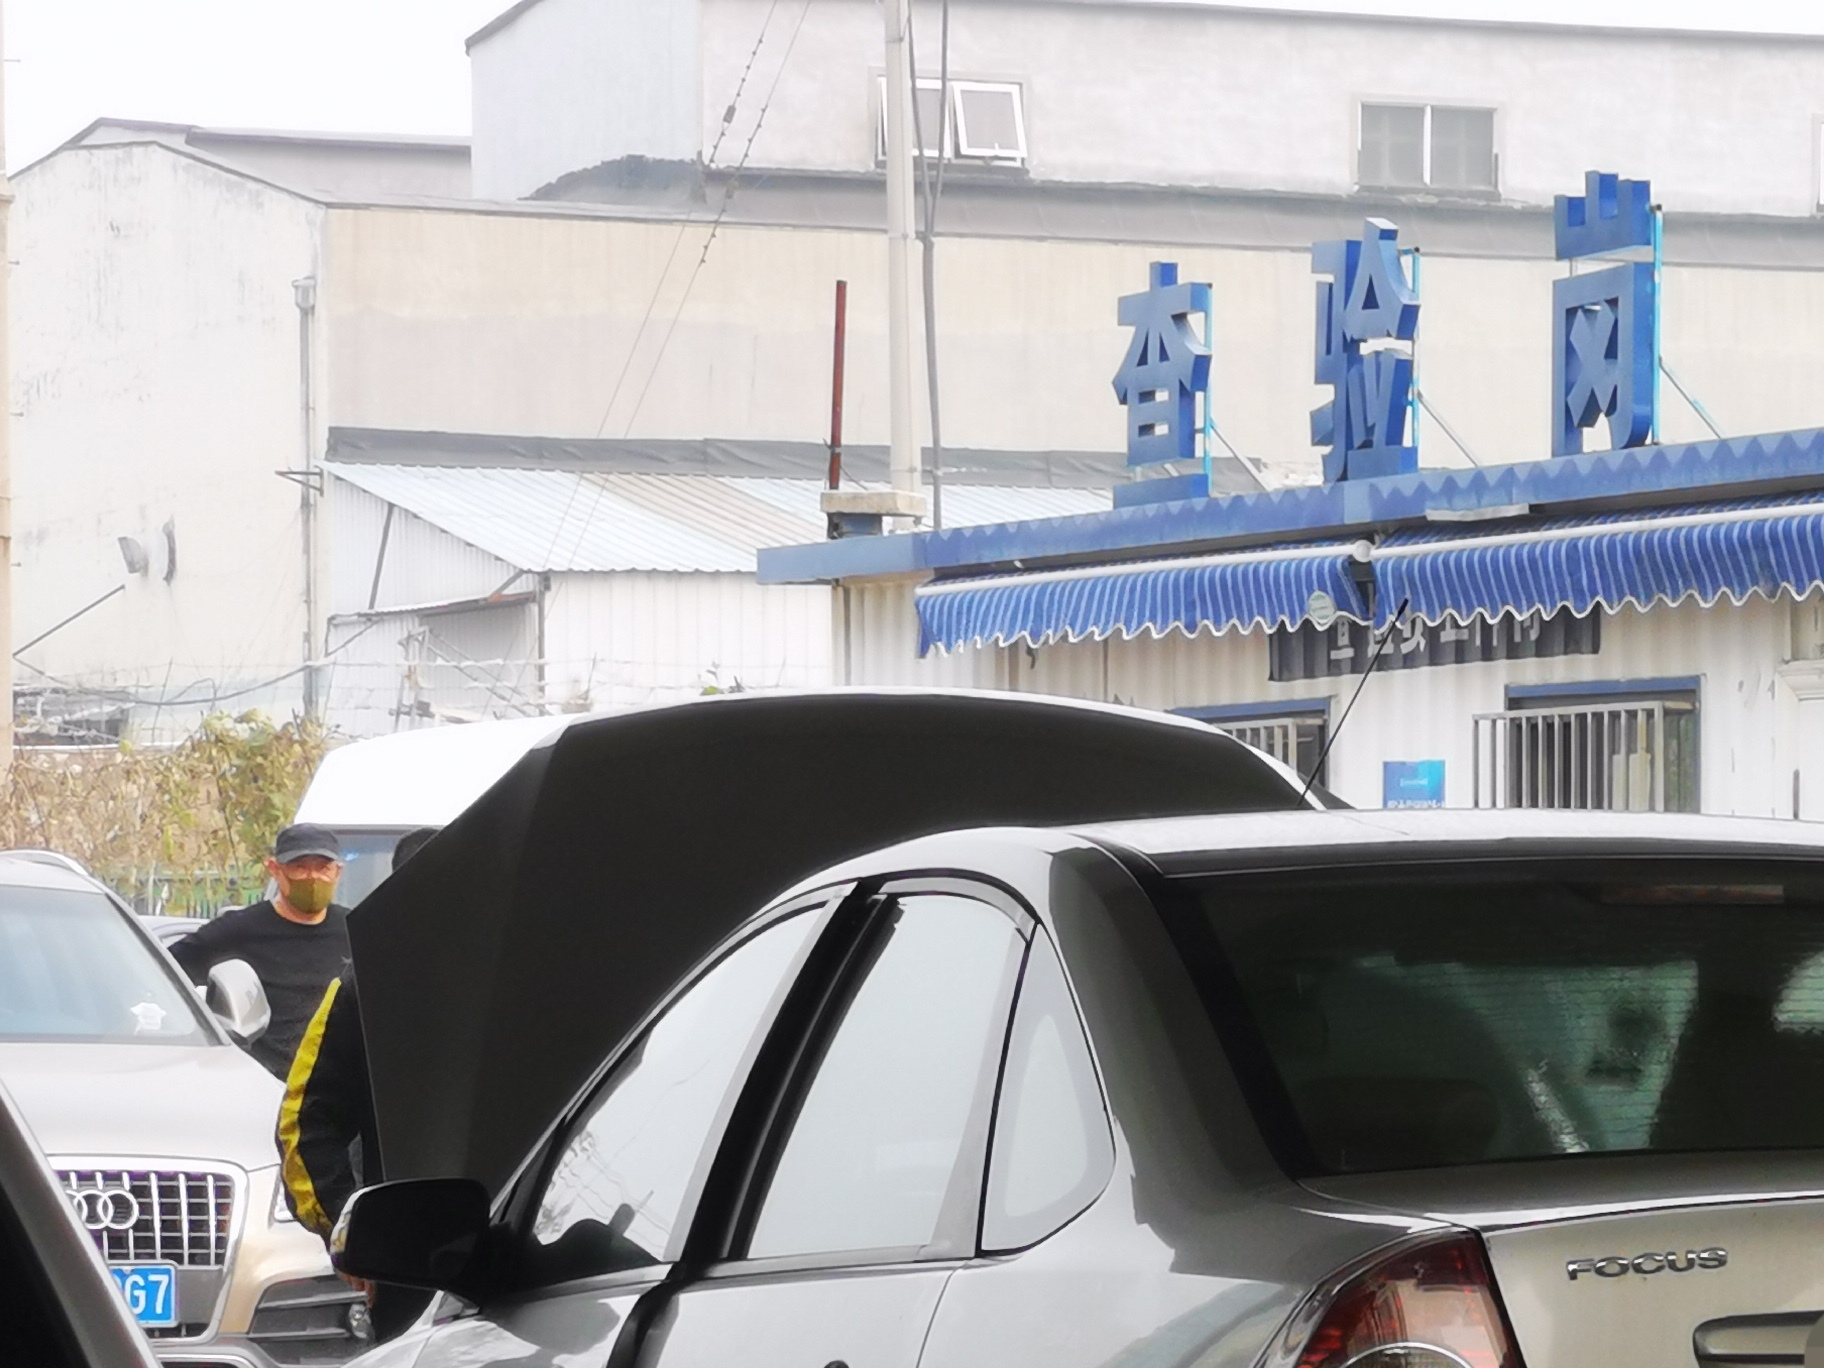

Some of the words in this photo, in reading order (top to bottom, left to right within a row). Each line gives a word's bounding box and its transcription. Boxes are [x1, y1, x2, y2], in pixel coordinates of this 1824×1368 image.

[1112, 170, 1652, 508] 查验岗
[1566, 1247, 1728, 1281] FOCUS
[114, 1273, 170, 1316] G7
